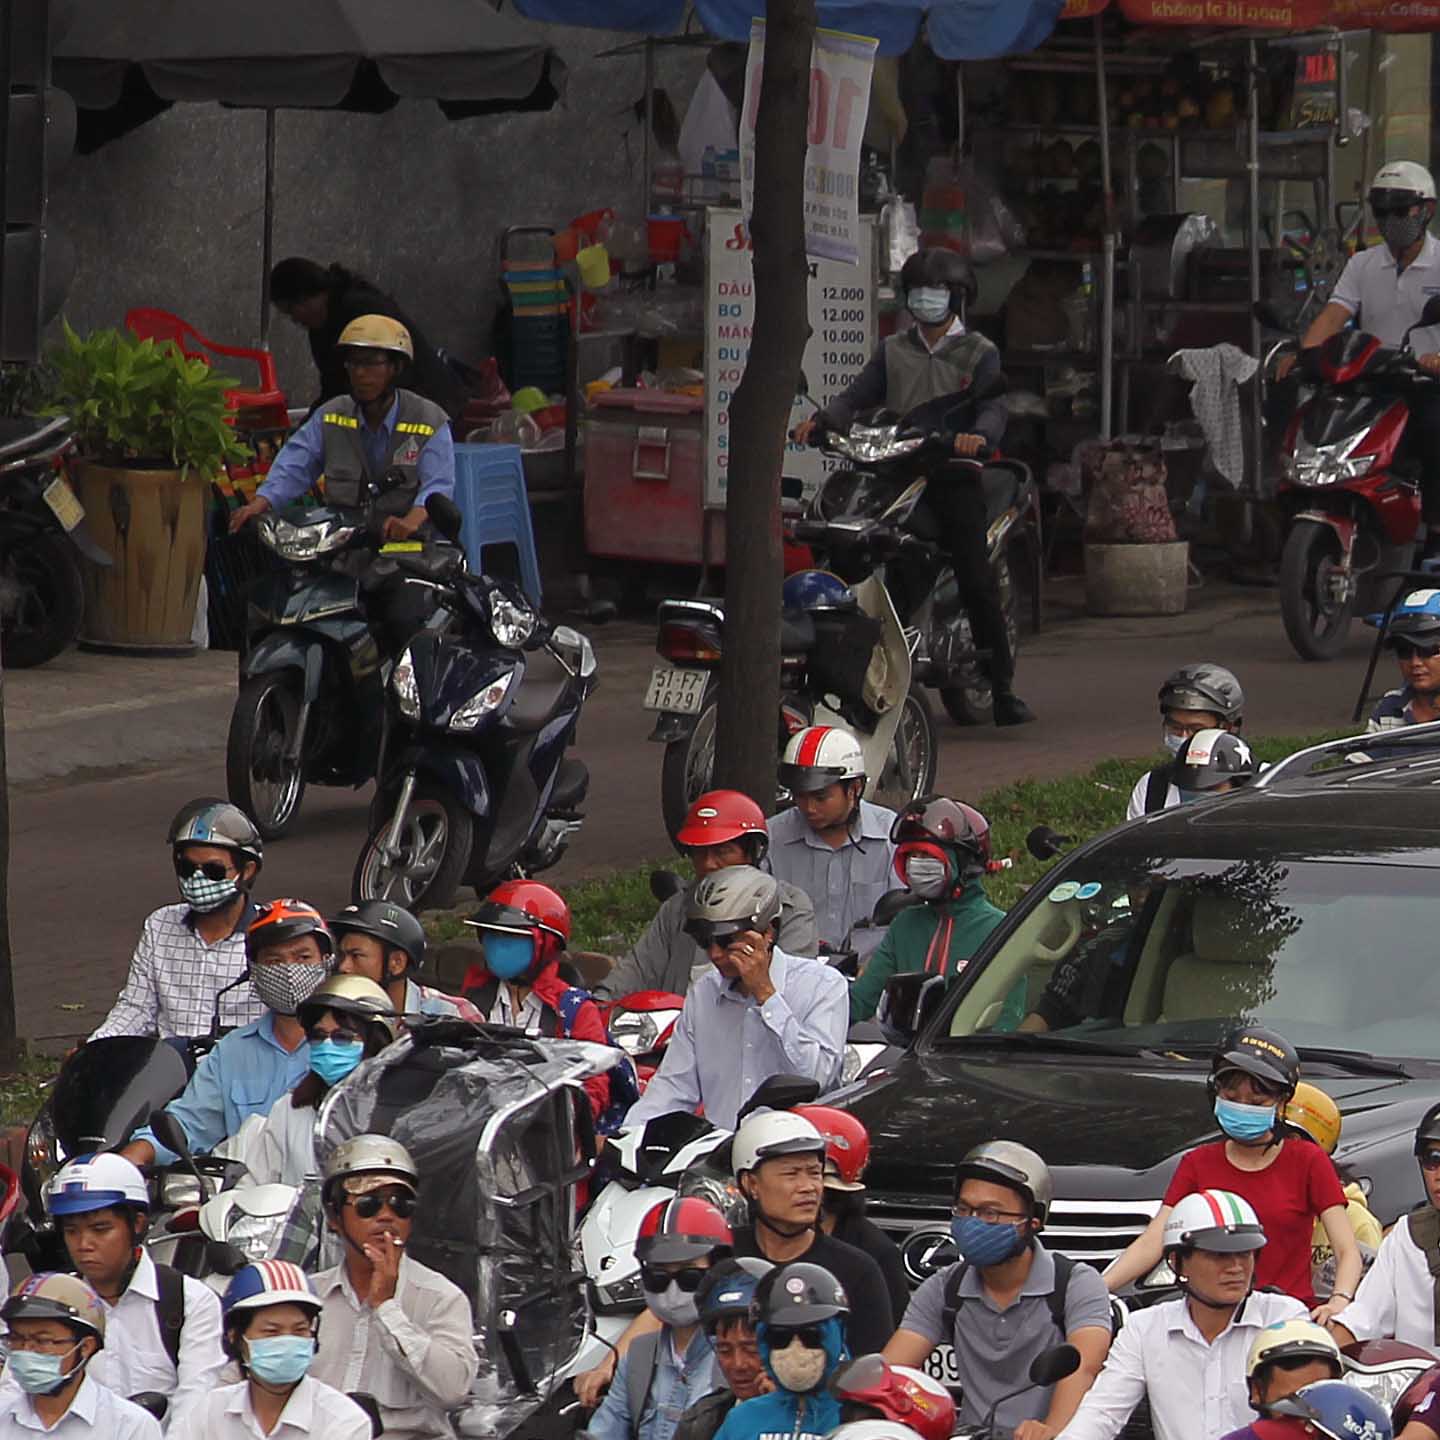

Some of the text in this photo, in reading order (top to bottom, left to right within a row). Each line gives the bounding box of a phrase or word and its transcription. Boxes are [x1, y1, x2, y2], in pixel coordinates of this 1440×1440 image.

[823, 288, 864, 302] 12.000
[823, 310, 864, 323] 12.000
[823, 331, 864, 344] 10.000
[823, 352, 864, 366] 10.000
[823, 374, 857, 387] 10.00
